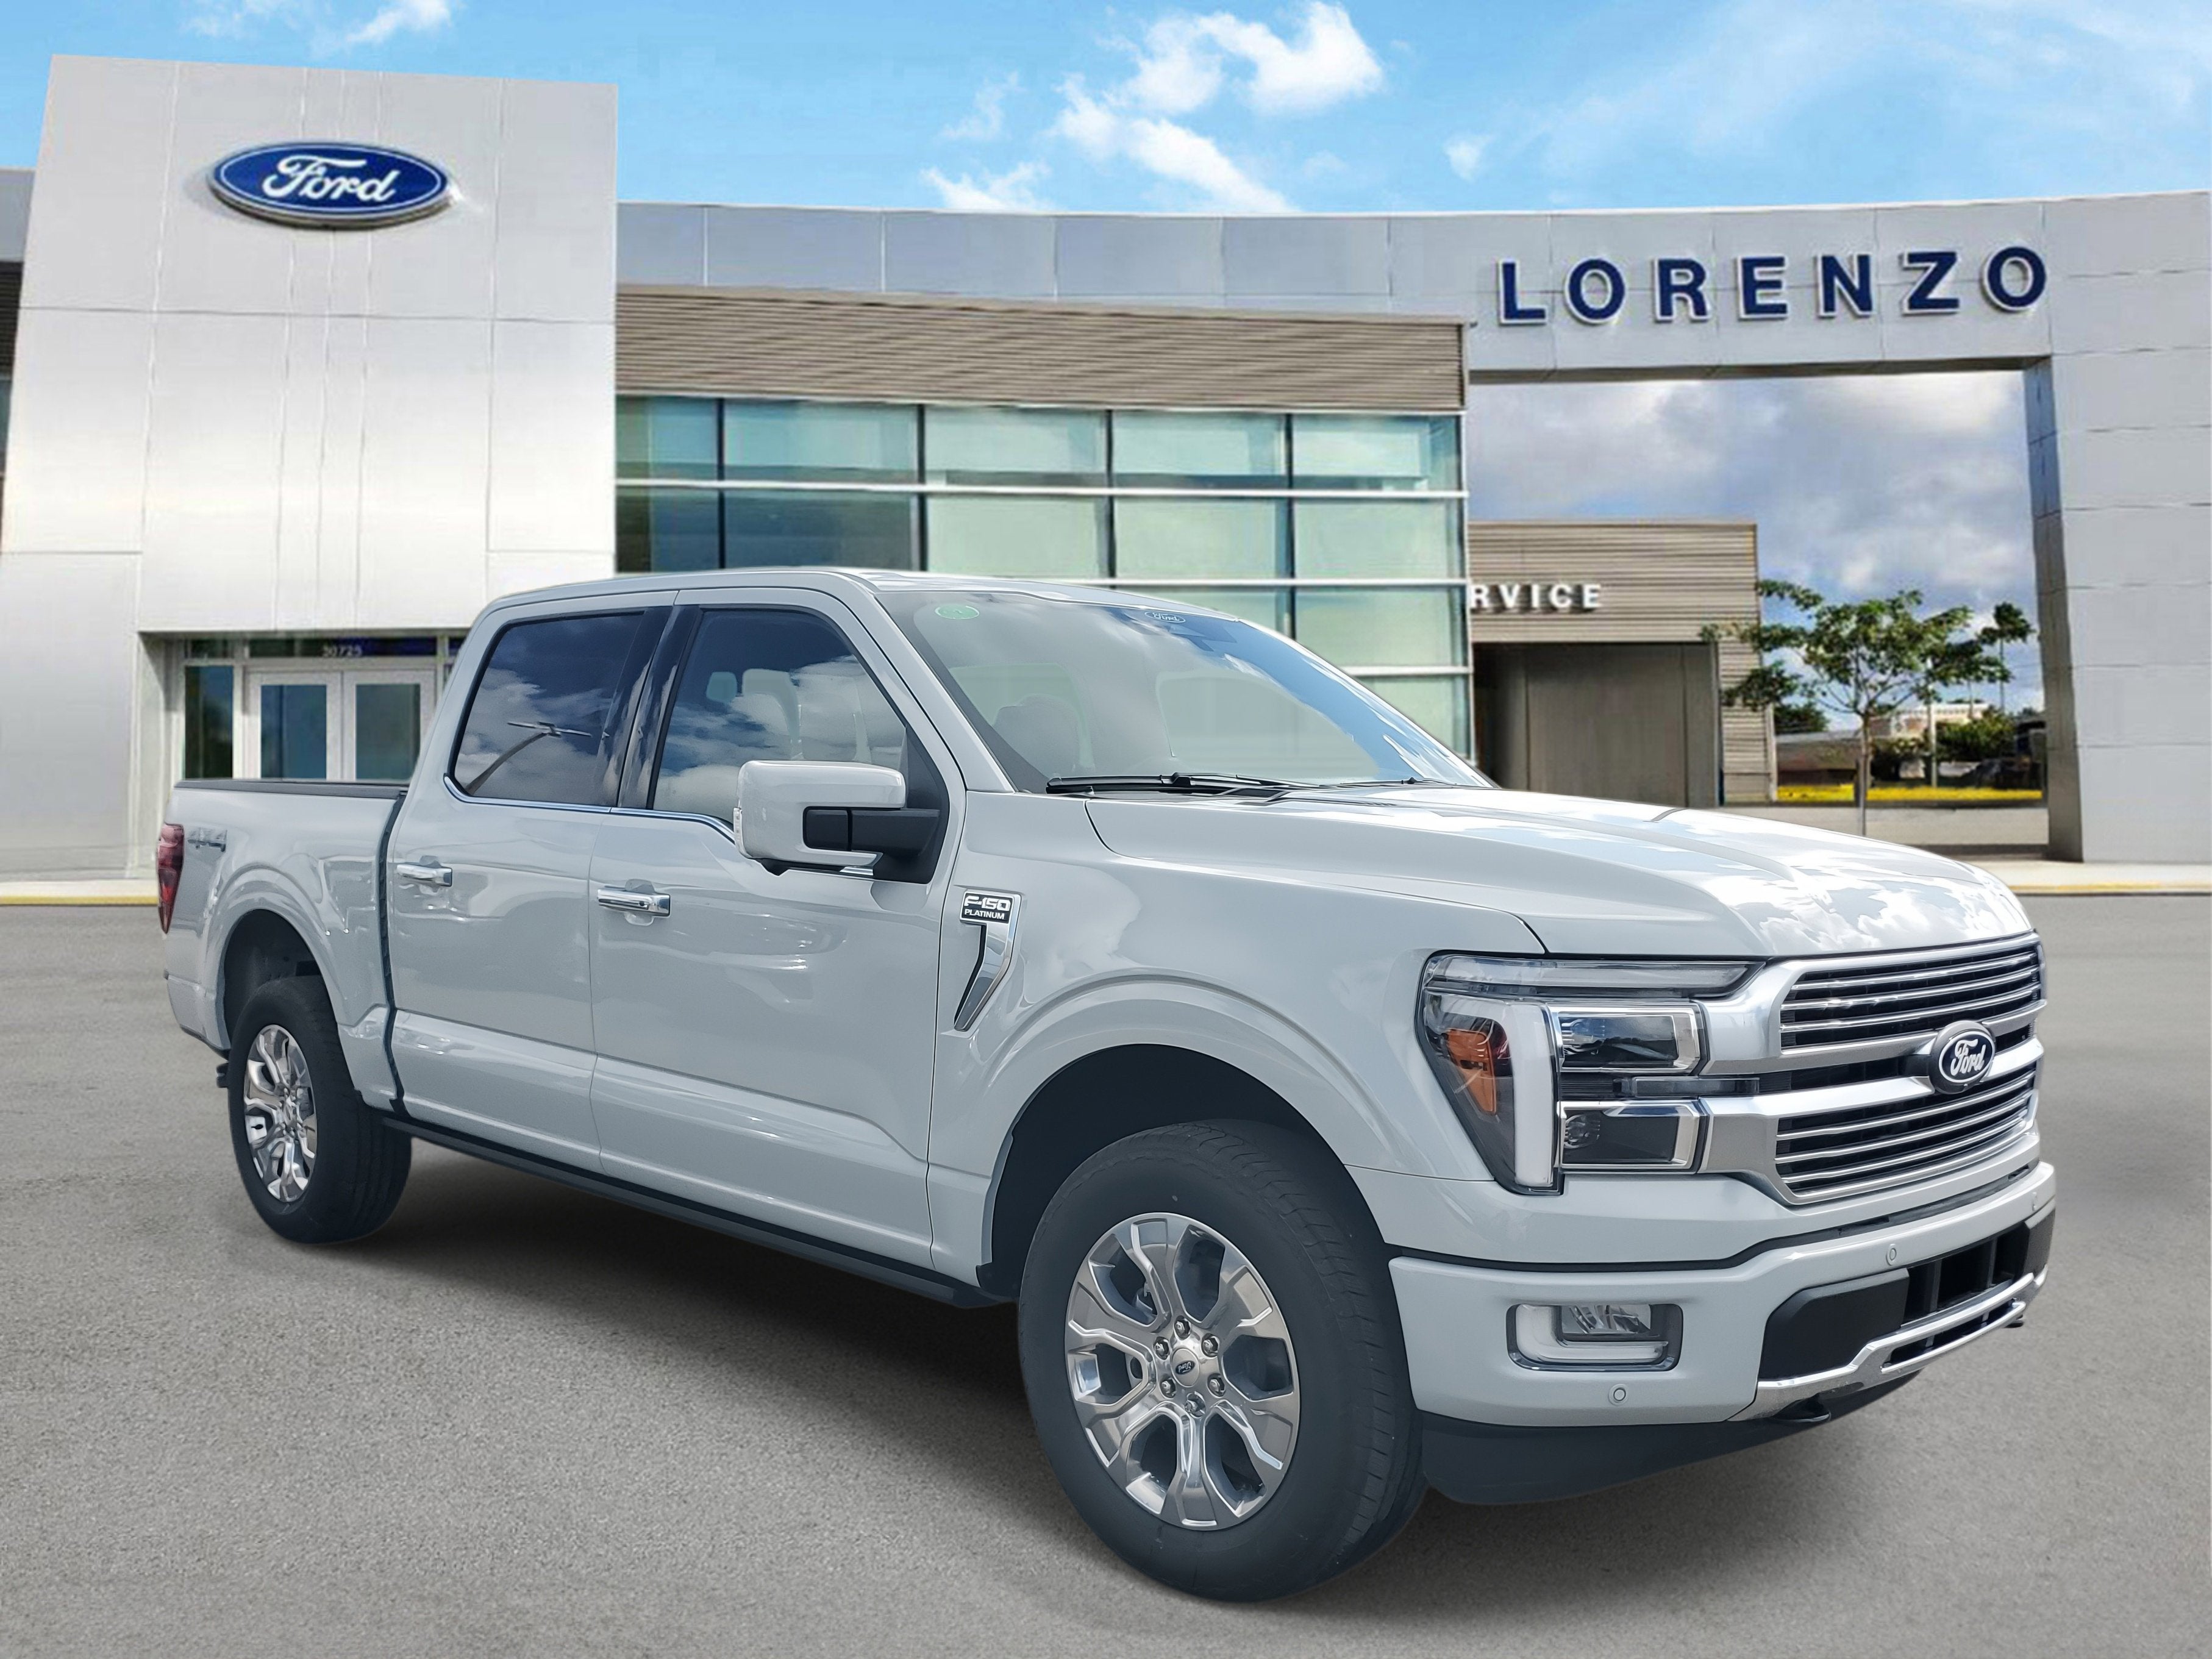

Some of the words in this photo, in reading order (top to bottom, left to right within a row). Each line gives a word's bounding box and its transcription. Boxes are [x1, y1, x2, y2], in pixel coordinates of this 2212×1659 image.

[262, 154, 401, 202] Ford
[1497, 245, 2047, 324] LORENZO
[965, 896, 1011, 912] F-150
[965, 909, 1005, 919] PLATINUM
[1951, 1039, 1986, 1076] Ford
[1178, 1361, 1192, 1373] Ford
